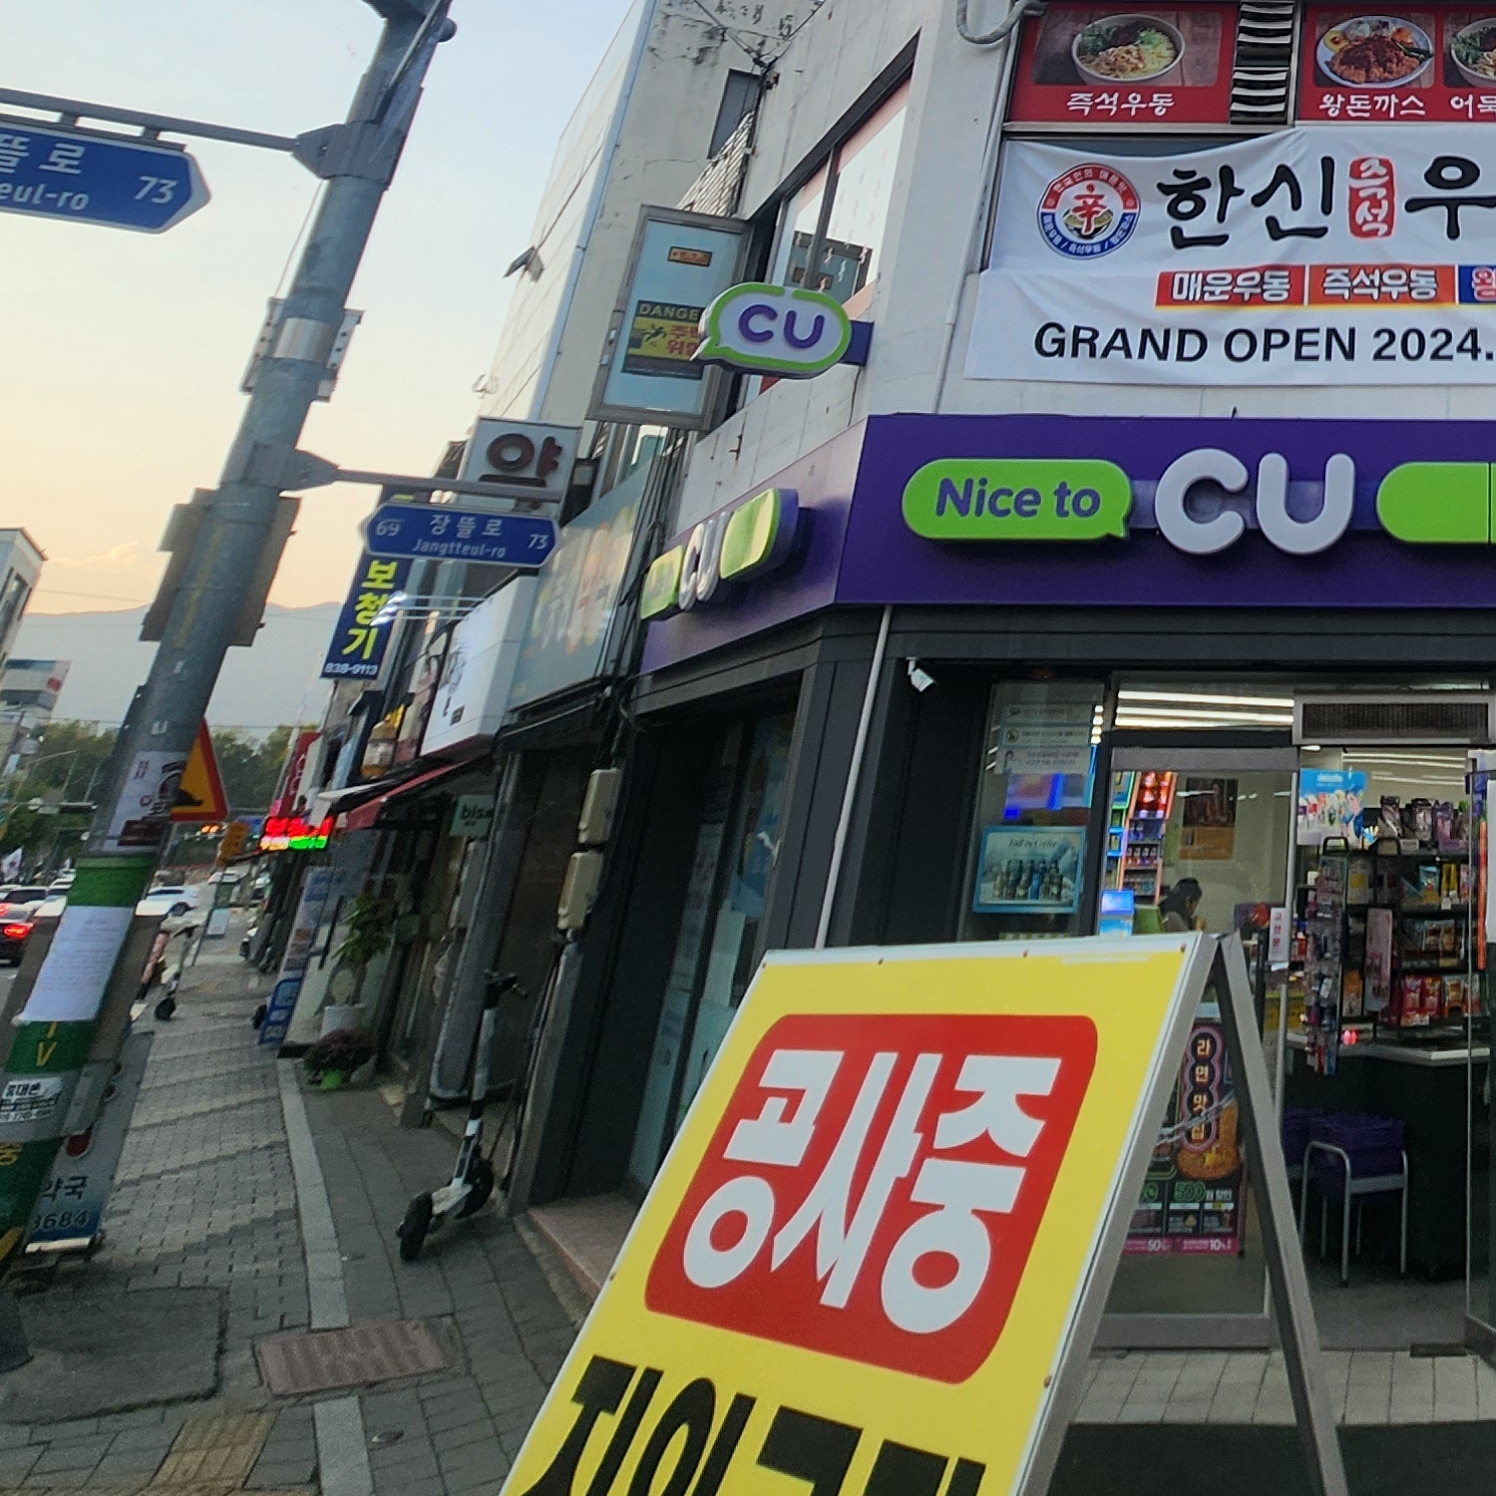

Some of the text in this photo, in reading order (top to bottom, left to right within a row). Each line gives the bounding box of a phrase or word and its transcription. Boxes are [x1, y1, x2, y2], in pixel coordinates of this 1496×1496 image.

[1066, 92, 1174, 118] 즉석우동
[1319, 92, 1426, 118] 왕돈까스
[134, 175, 177, 204] 73
[1156, 155, 1336, 250] 한신
[1351, 157, 1394, 237] 즉석
[1171, 270, 1291, 303] 매운우동
[1321, 267, 1438, 301] 즉석우동
[640, 303, 699, 321] DANGE
[738, 304, 826, 349] CU
[1034, 321, 1208, 363] GRAND
[1223, 325, 1357, 362] OPEN
[1372, 327, 1494, 362] 2024.
[934, 447, 1357, 555] Nice to CU
[376, 518, 401, 538] 69
[430, 514, 503, 539] 장뜰로
[528, 533, 549, 550] 73
[412, 538, 506, 558] Jangtteul-ro
[342, 560, 397, 660] 보청기
[683, 1049, 1063, 1334] 공사중
